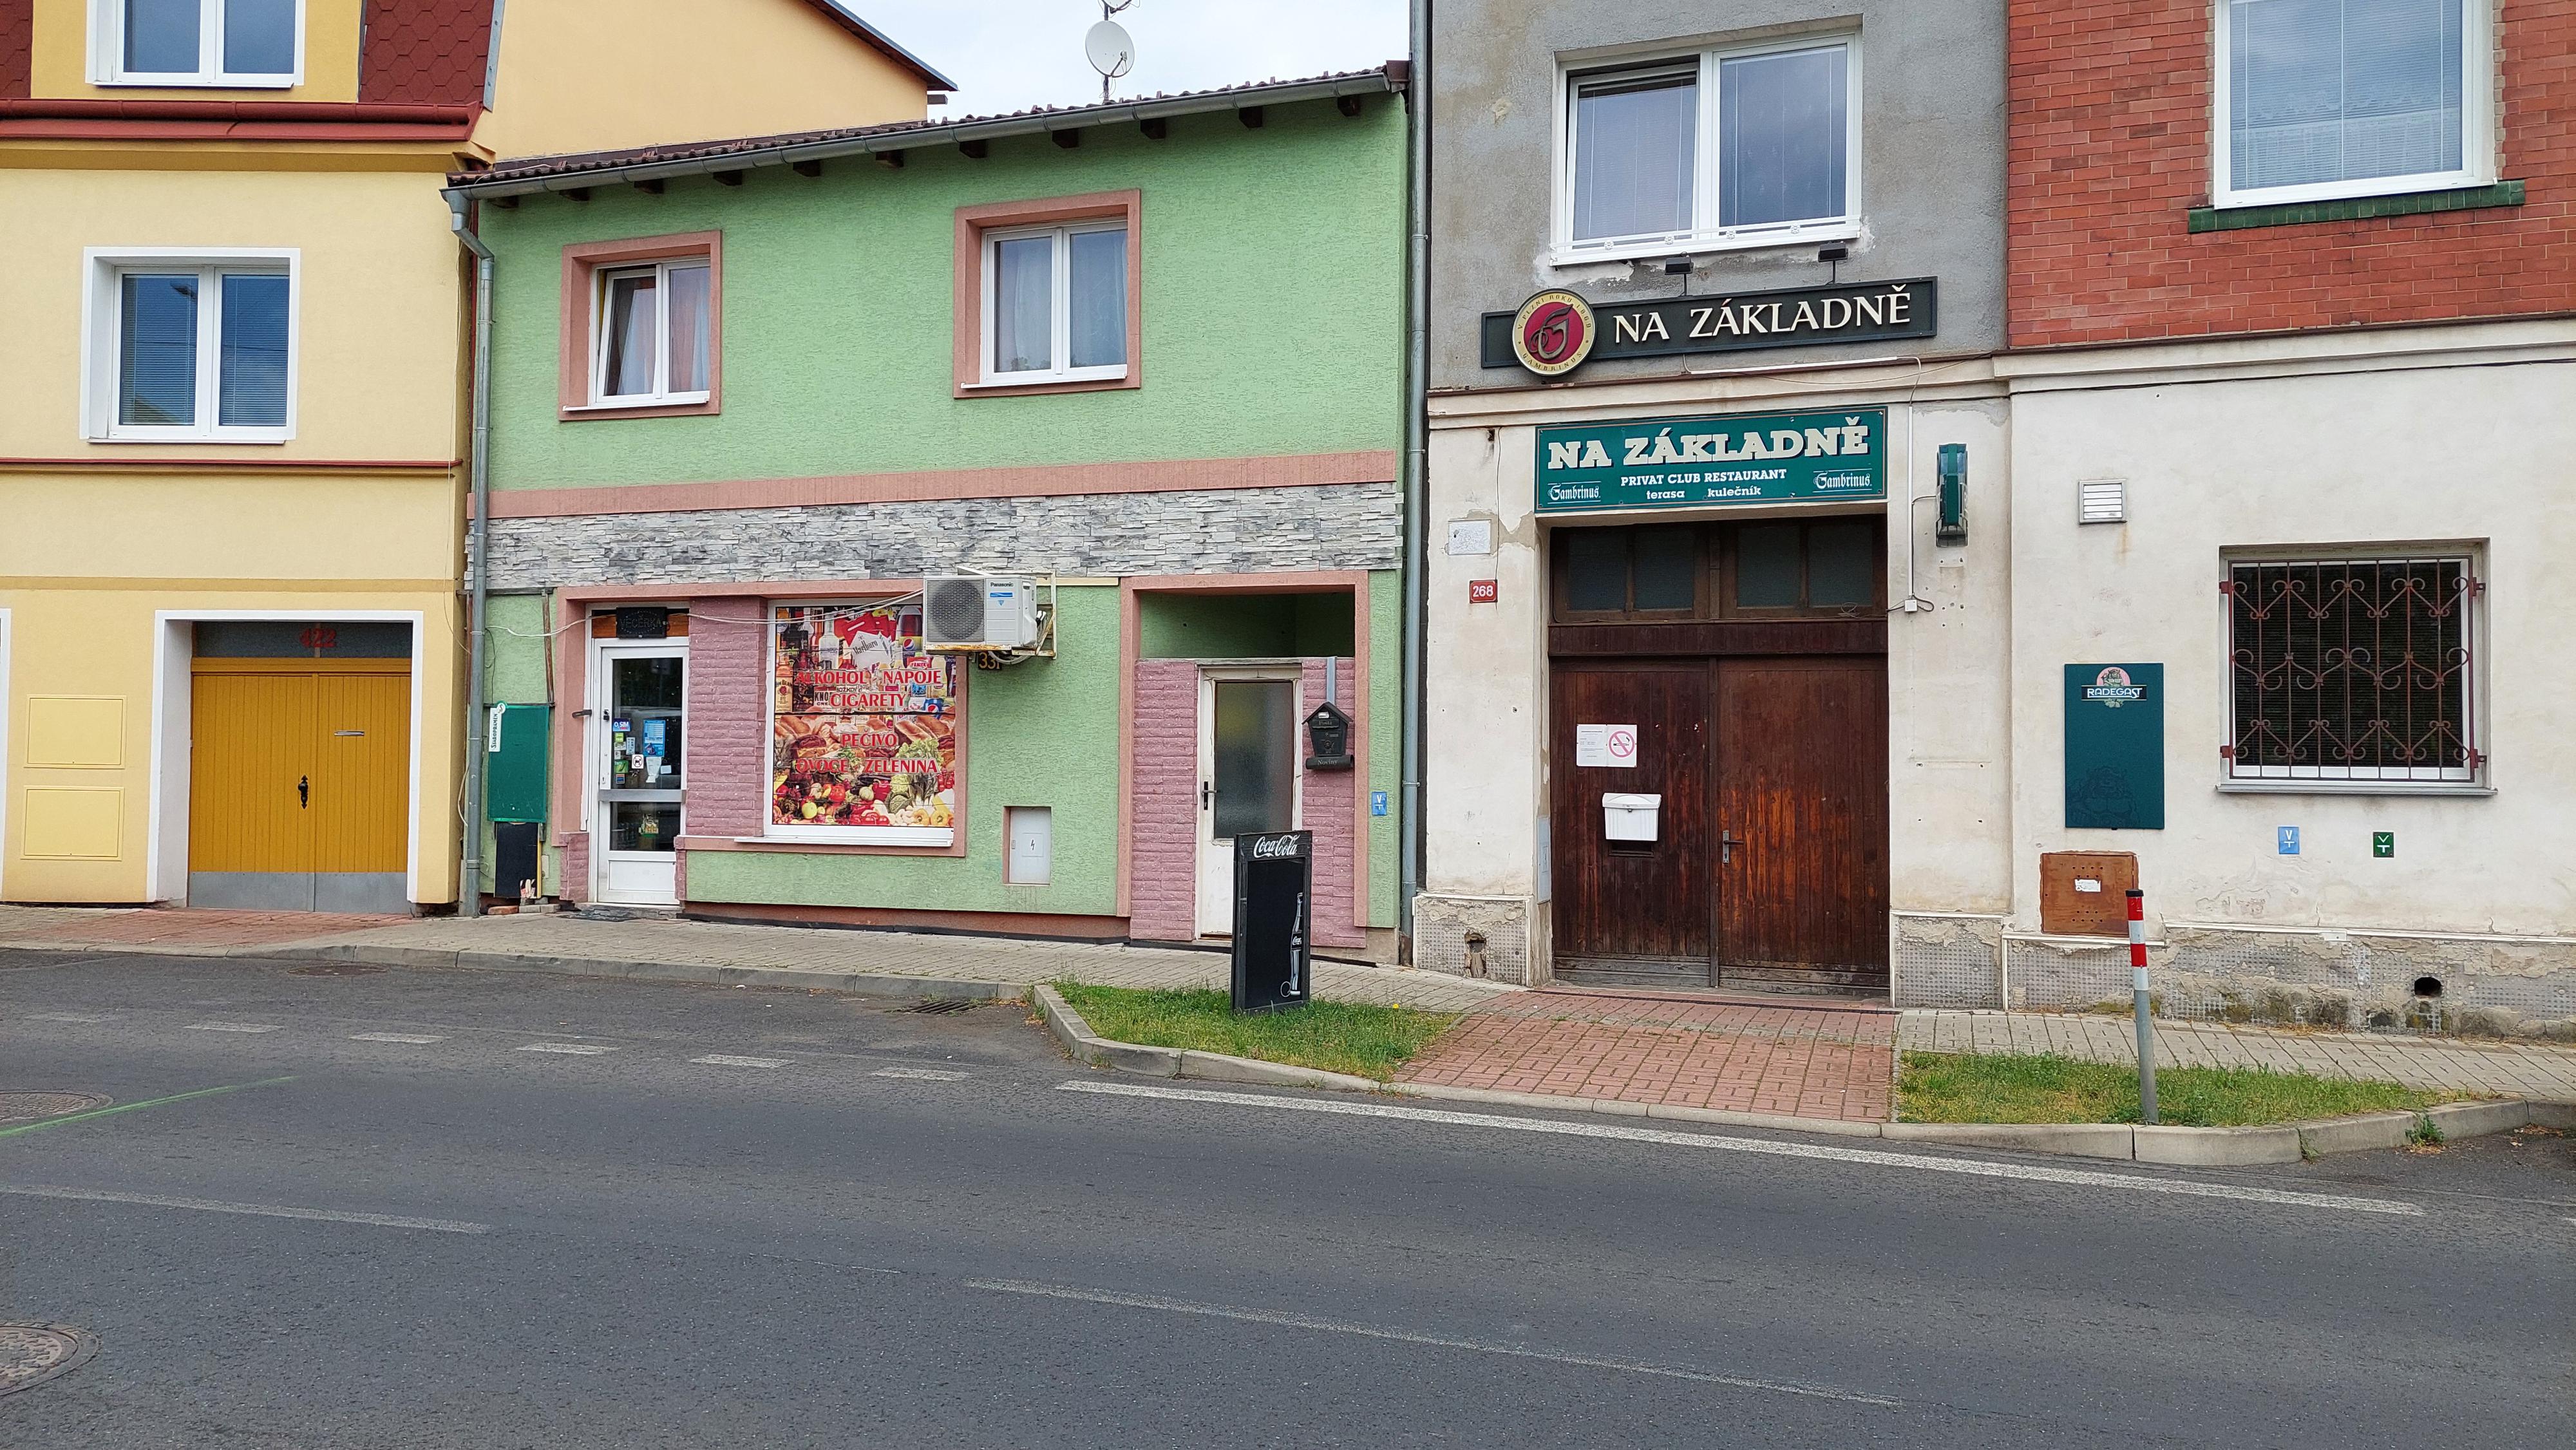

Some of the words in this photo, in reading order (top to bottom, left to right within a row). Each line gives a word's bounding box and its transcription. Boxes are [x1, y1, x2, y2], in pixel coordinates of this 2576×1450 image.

[1549, 294, 1573, 303] ROKU
[1613, 312, 1669, 343] NA
[1689, 284, 1911, 337] ZÁKLADNĚ
[1522, 352, 1582, 372] GAMBRINUS
[1548, 440, 1612, 469] NA
[1623, 417, 1868, 466] ZÁKLADNĚ
[1620, 475, 1663, 487] PRIVAT
[1667, 473, 1700, 484] CLUB
[1704, 469, 1786, 483] RESTAURANT
[1813, 472, 1872, 489] Gambrinus
[1548, 484, 1601, 501] Gambrinus
[1646, 489, 1685, 500] terasa
[1707, 485, 1761, 498] kulečník
[1472, 585, 1494, 598] 268
[795, 671, 866, 684] ALKOHOL
[829, 693, 906, 707] CIGARETY
[2087, 688, 2143, 699] RADEGAST
[841, 729, 898, 747] PEČIVO
[796, 758, 849, 773] OVOCE
[865, 758, 938, 773] ZELENINA
[1253, 834, 1301, 858] Coca-Cola
